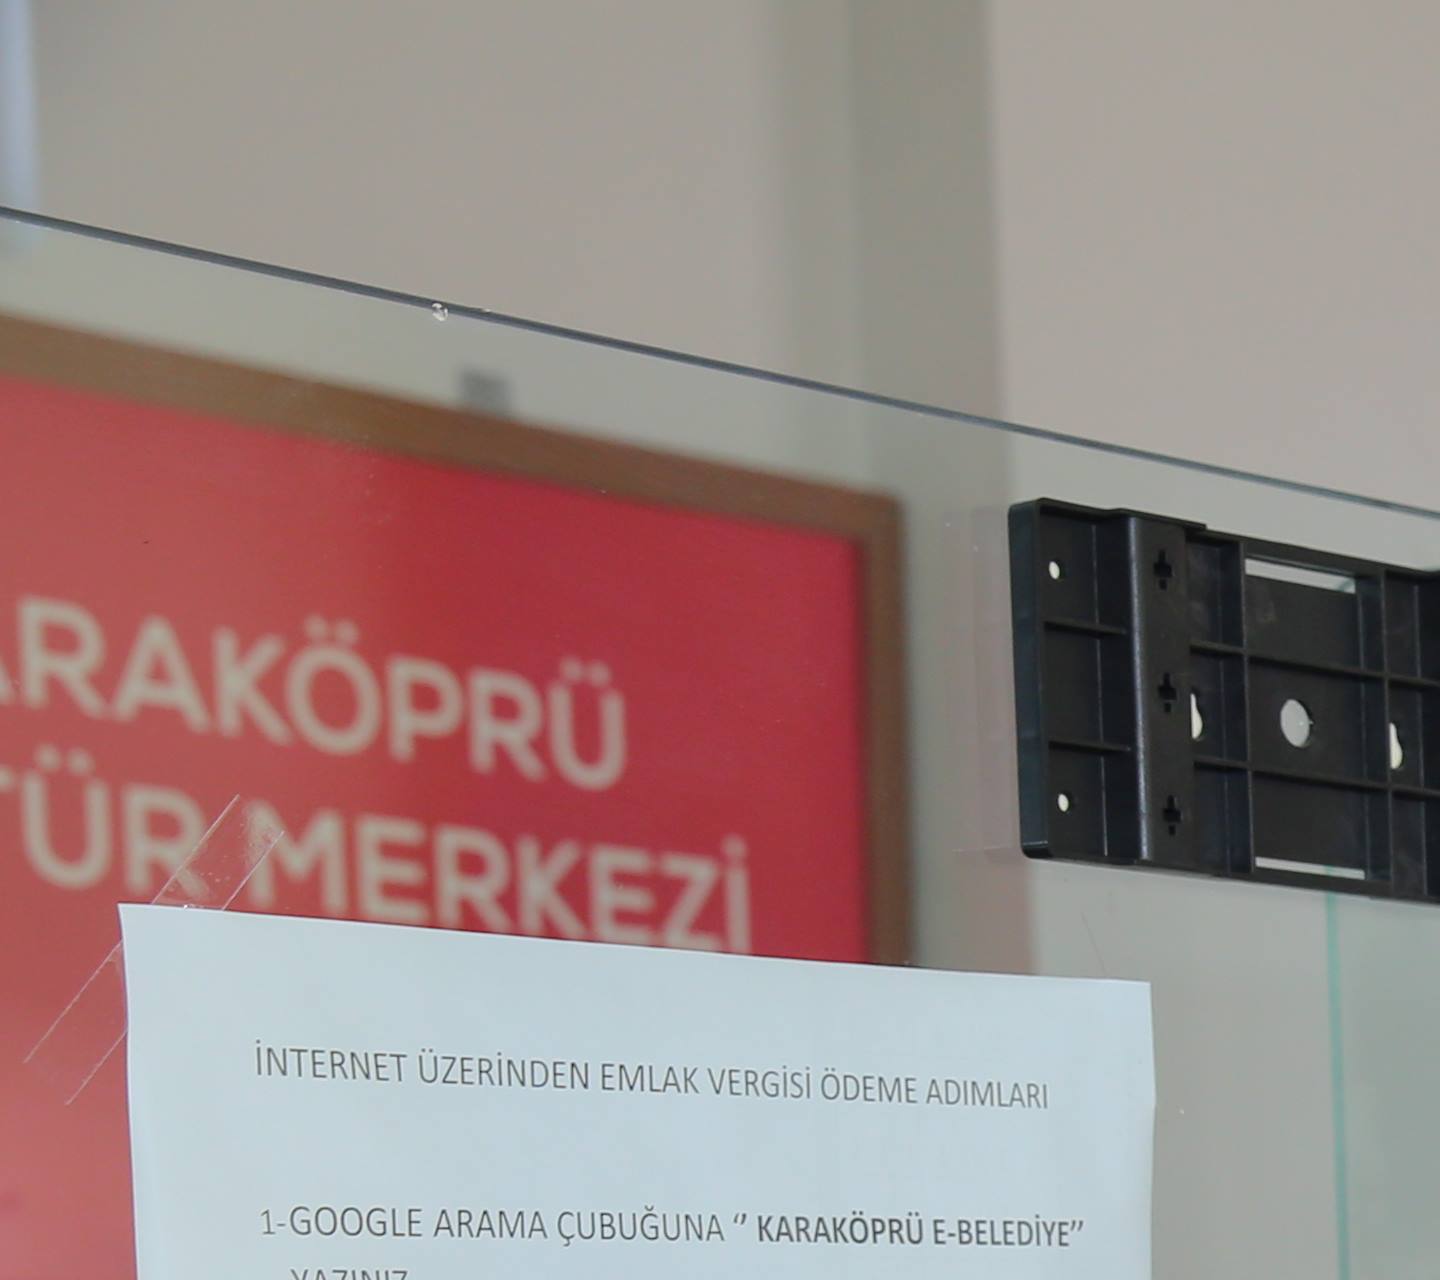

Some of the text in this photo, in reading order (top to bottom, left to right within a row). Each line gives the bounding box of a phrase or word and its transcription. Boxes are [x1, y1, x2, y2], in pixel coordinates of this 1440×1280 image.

[0, 596, 628, 791] RAKÖPRÜ
[0, 742, 752, 953] ÜR MERKEZİ
[255, 1039, 1048, 1109] İNTERNET ÜZERİNDEN EMLAK VERGİSİ ÖDEME ADIMLARI
[432, 1208, 548, 1239] ARAMA
[556, 1204, 725, 1247] ÇUBUĞUNA
[757, 1210, 924, 1246] KARAKÖPRÜ
